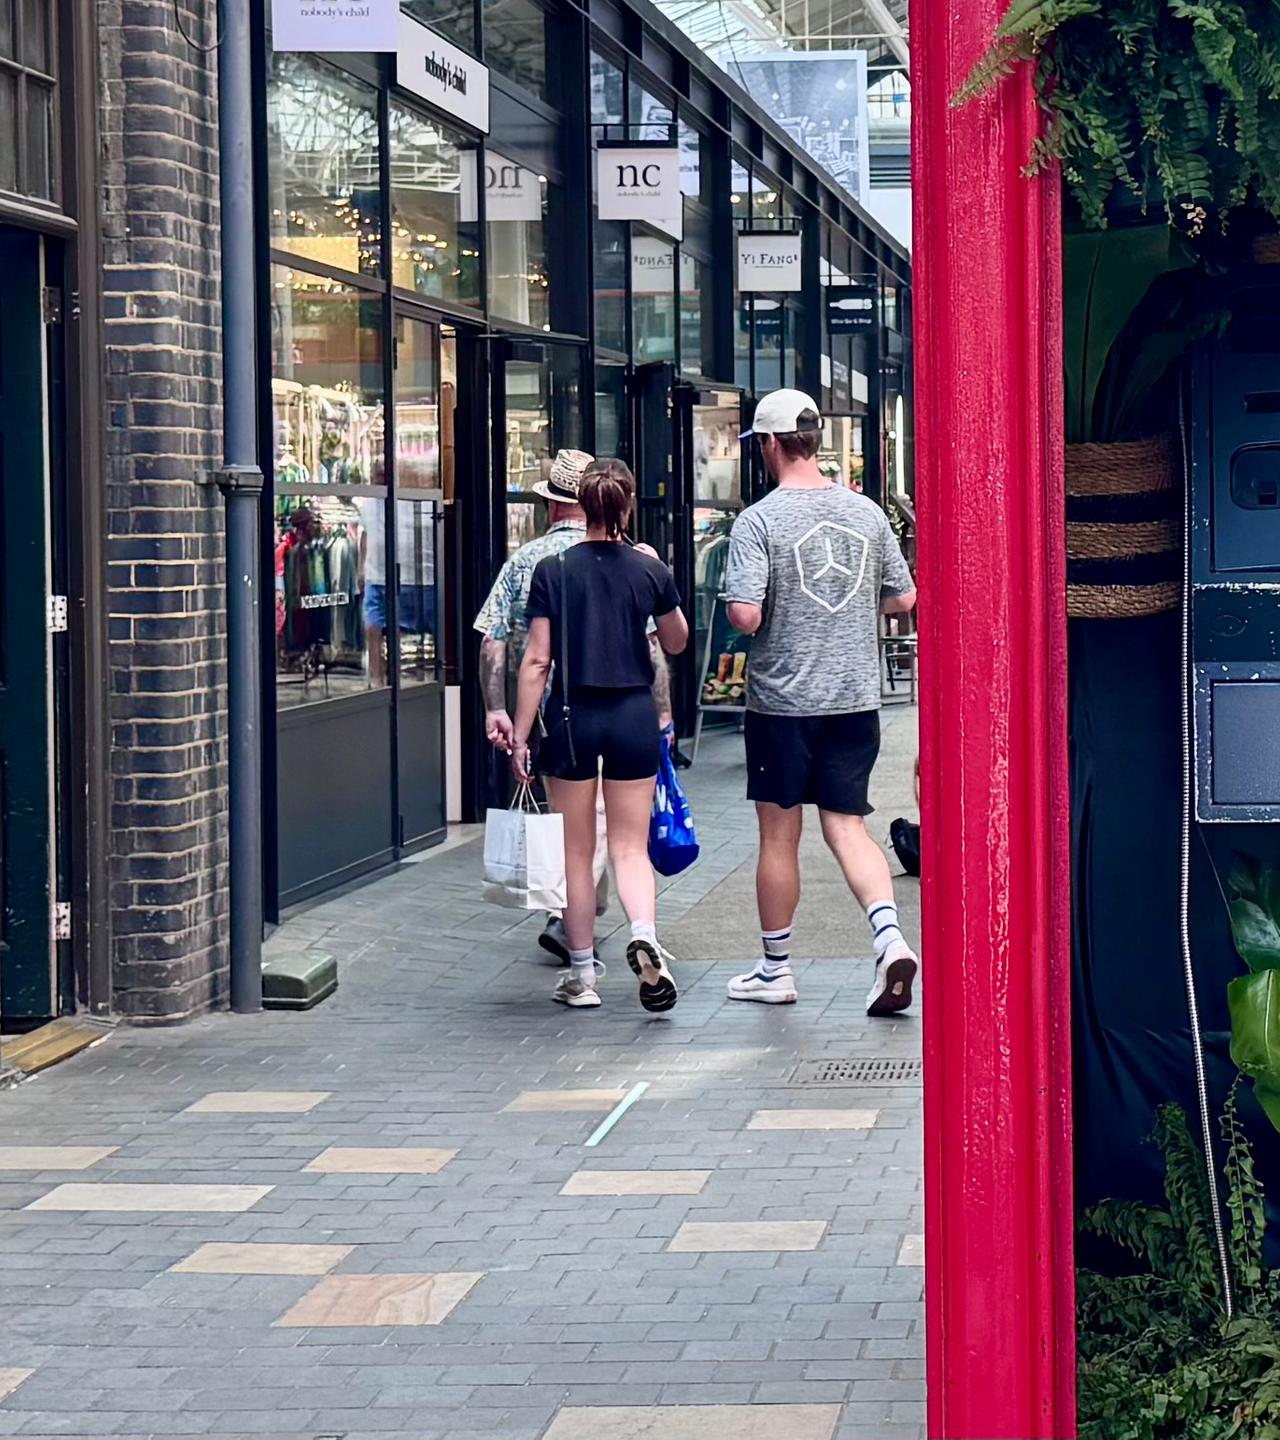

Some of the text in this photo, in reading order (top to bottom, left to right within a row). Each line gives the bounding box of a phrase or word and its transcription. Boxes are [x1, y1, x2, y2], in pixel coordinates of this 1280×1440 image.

[300, 6, 370, 20] nobody's child
[616, 164, 661, 188] nc
[741, 253, 793, 265] YI FANG
